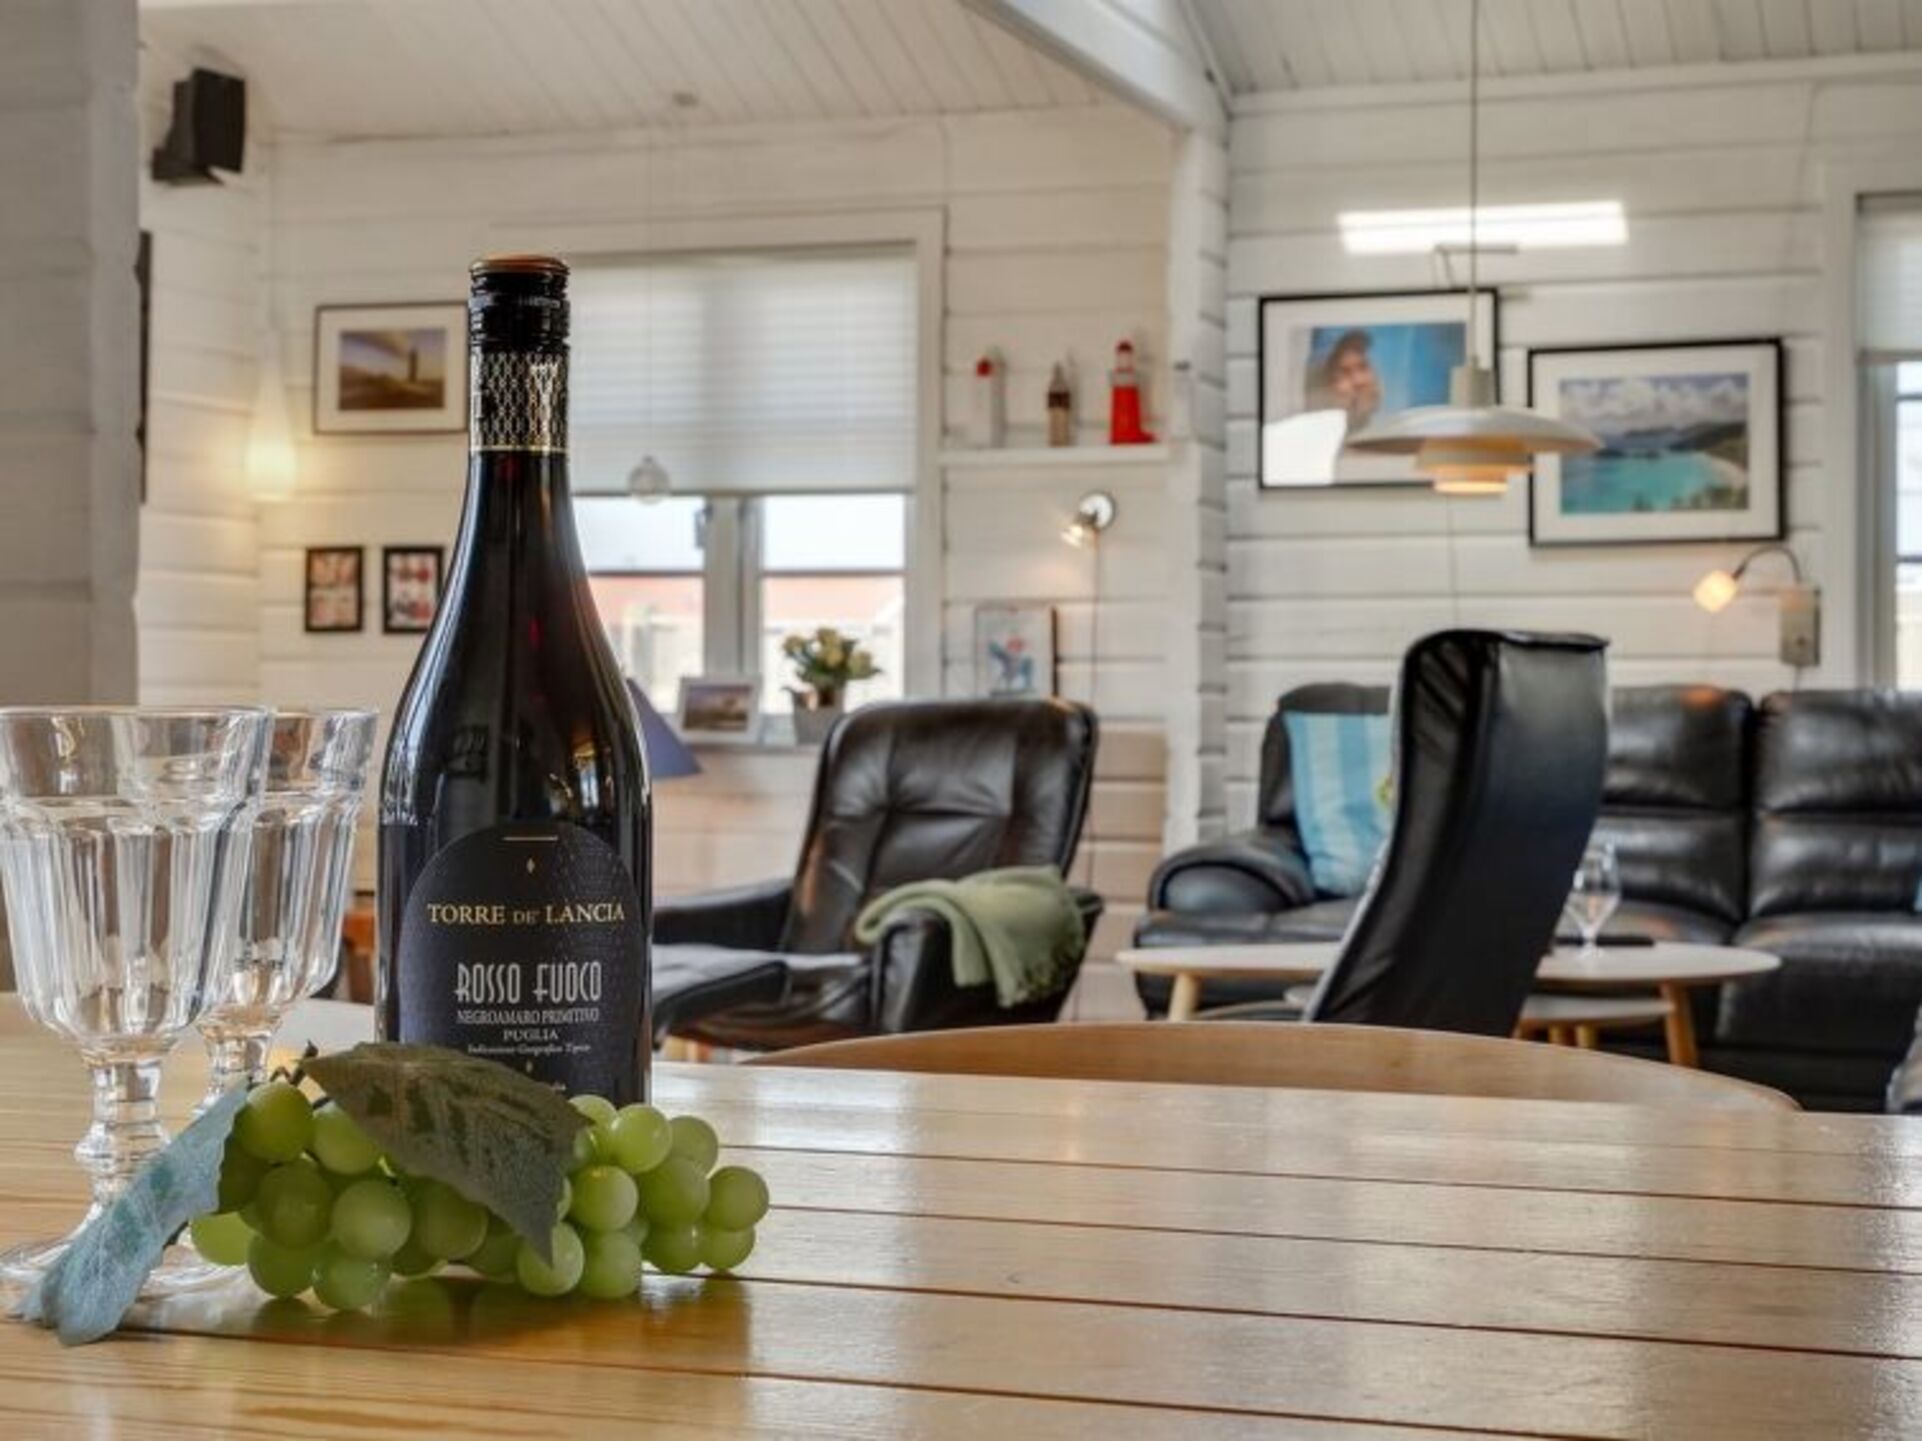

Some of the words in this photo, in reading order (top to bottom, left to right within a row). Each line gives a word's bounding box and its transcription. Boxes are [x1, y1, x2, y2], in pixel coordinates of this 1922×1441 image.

[426, 903, 505, 925] TORRE
[546, 902, 625, 923] LANCIA
[455, 962, 521, 1005] ROSSO
[532, 961, 602, 1004] FUOCO
[457, 1009, 541, 1025] NEGROAMARO
[503, 1029, 559, 1042] PUGLIA
